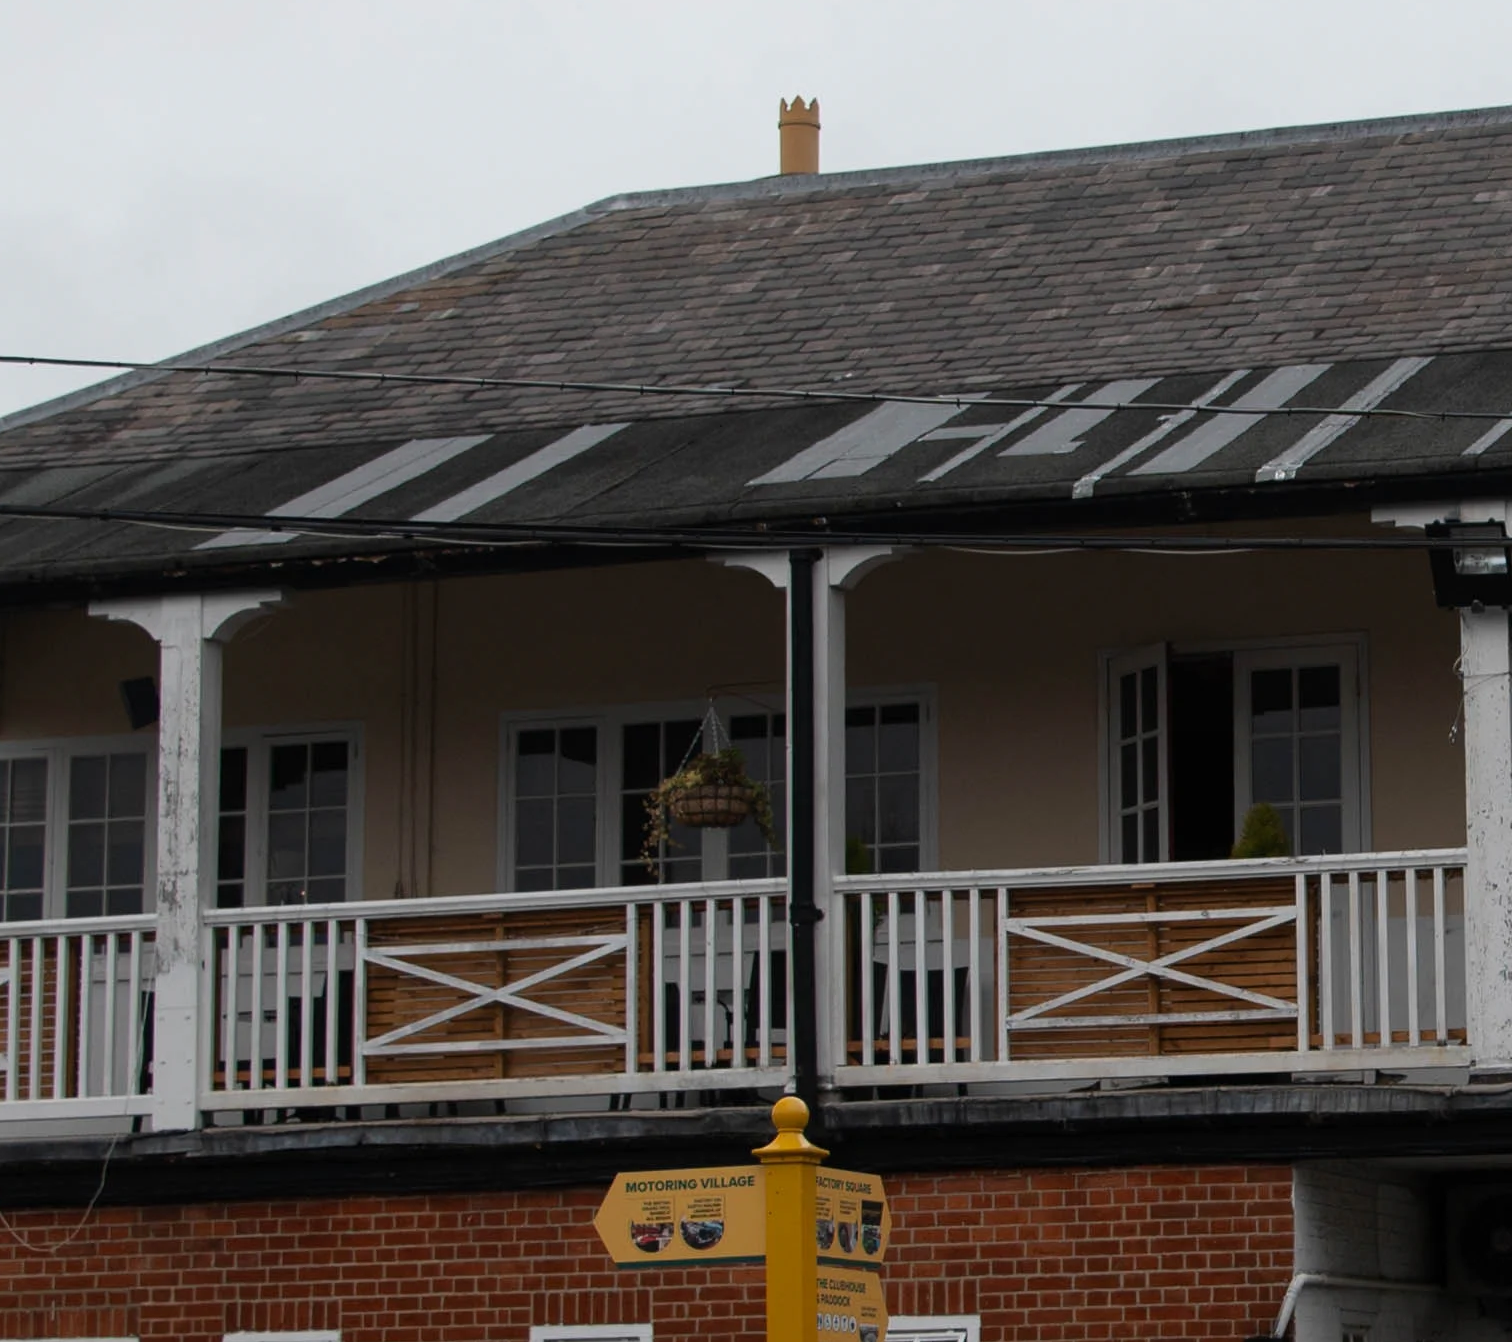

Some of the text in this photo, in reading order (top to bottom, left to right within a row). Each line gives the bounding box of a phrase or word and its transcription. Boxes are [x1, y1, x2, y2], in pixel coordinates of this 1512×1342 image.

[626, 1175, 756, 1193] MOTORING VILLAGE
[845, 1180, 872, 1195] SQUARE
[829, 1278, 866, 1294] CLUBHOUSE
[821, 1293, 851, 1307] PADDOCK
